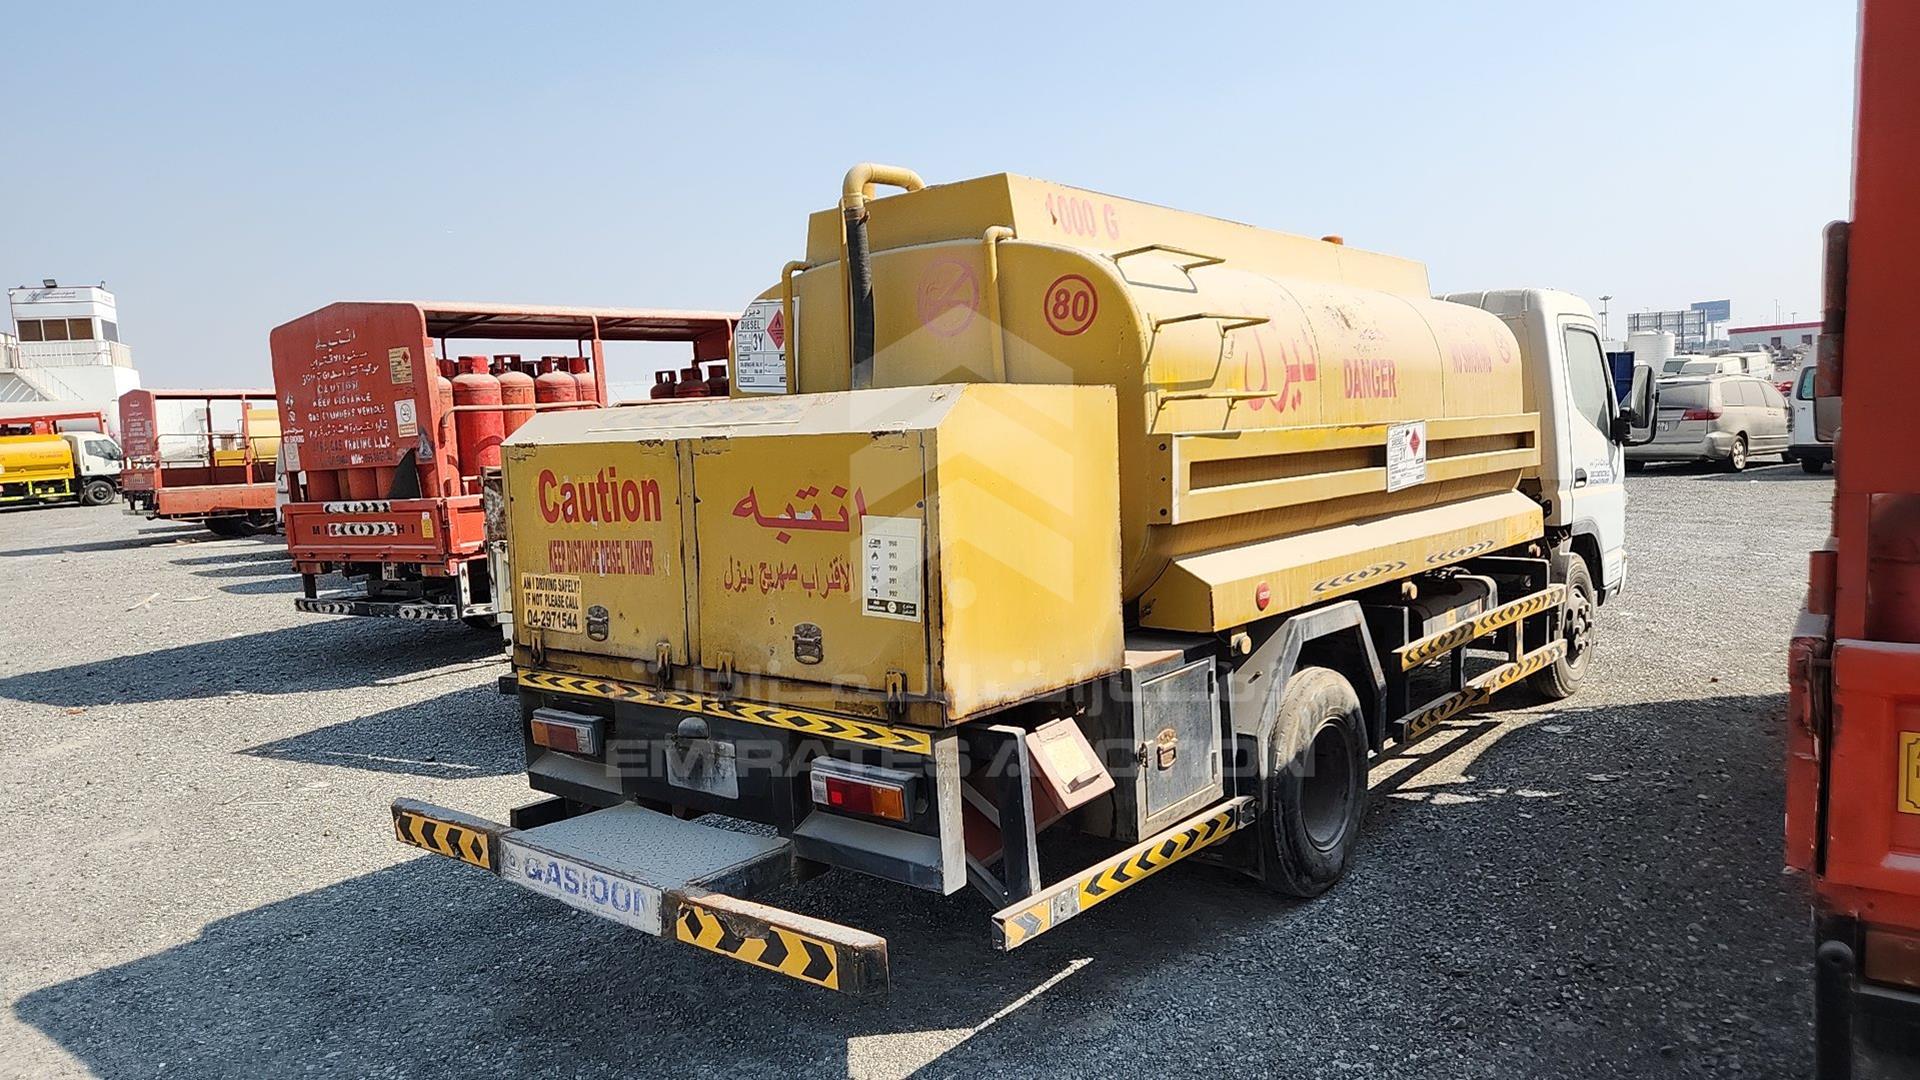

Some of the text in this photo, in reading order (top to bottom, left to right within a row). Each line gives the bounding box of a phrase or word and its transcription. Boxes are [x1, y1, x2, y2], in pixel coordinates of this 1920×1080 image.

[1052, 288, 1089, 322] 80
[740, 320, 760, 330] DIESEL
[1344, 359, 1397, 399] DANGER
[538, 466, 662, 524] Caution
[732, 485, 867, 544] انتبه
[548, 540, 565, 573] KEEP
[566, 540, 600, 573] DISTANCE
[625, 540, 655, 575] TANKER
[723, 554, 754, 593] ديزل
[523, 576, 531, 589] AM
[536, 577, 557, 592] DRIVING
[557, 579, 580, 593] SAFELY?
[526, 592, 578, 610] IF NOT PLEASE CALL
[527, 608, 578, 630] 04-2971544
